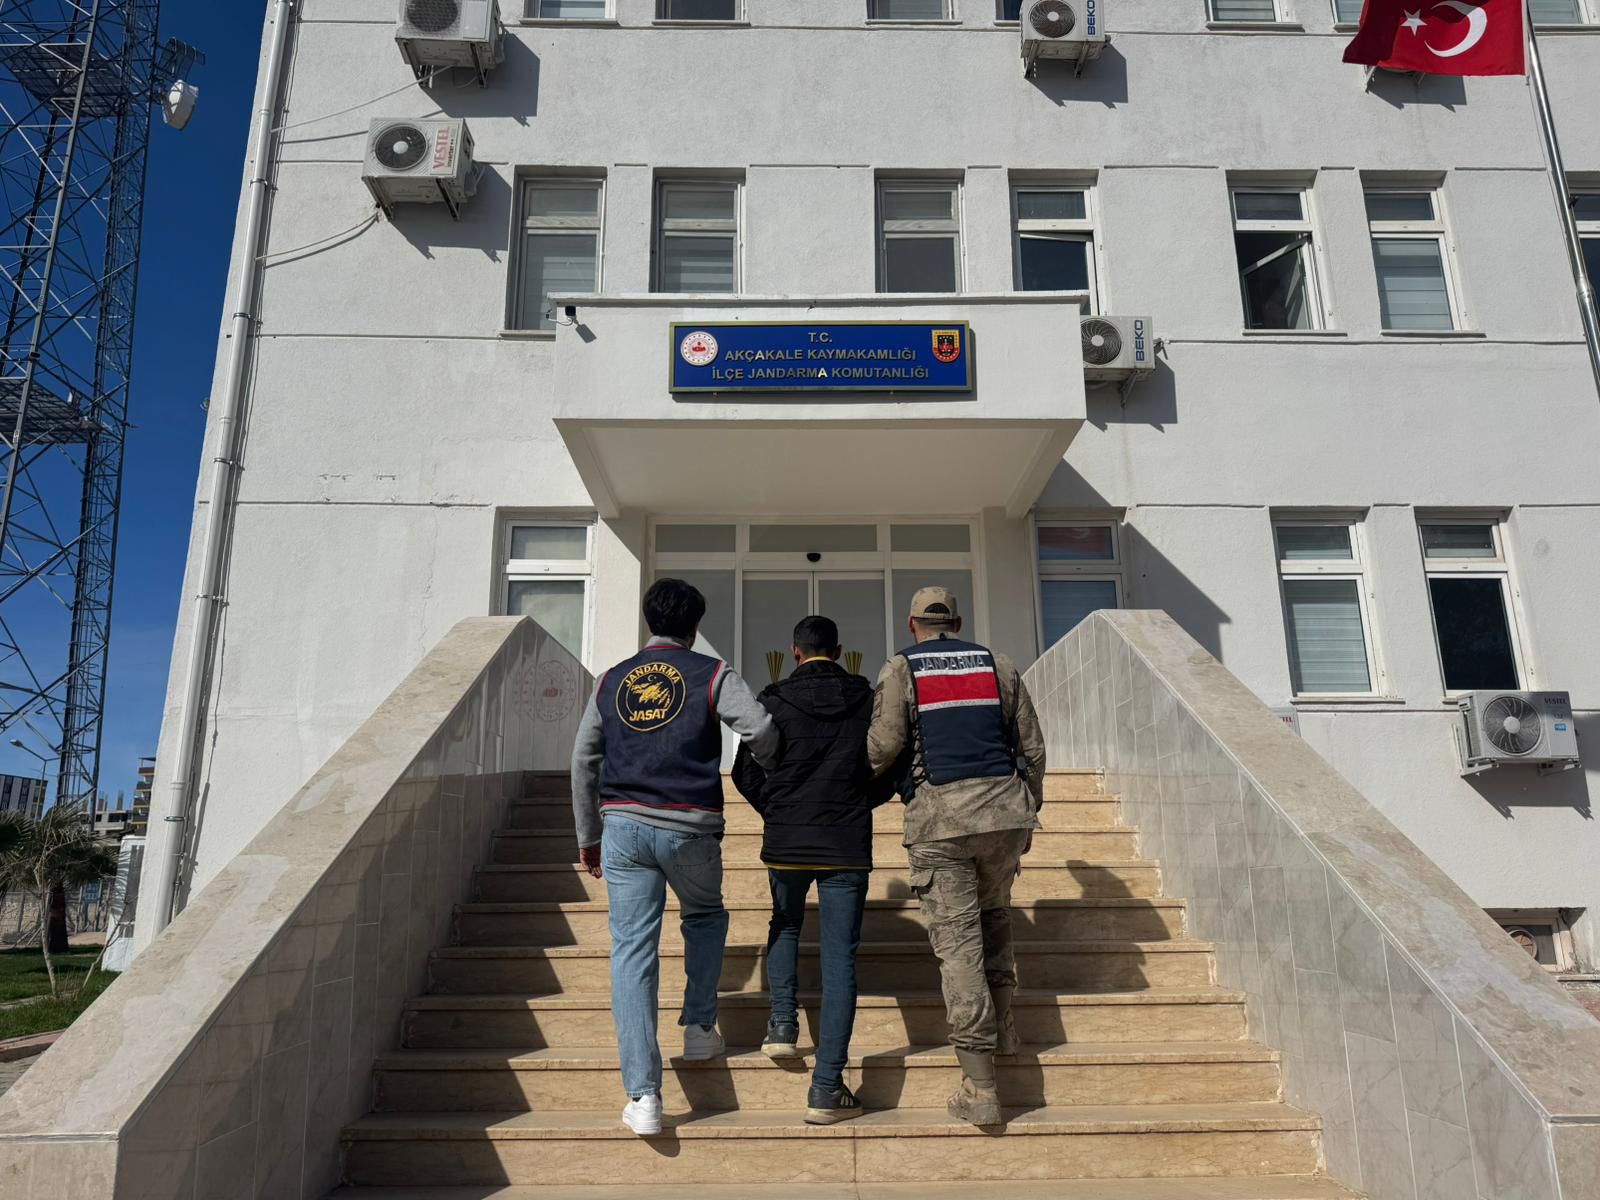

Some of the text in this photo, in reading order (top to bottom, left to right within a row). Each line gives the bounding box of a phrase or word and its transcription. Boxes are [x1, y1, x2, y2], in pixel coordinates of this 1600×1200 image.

[1087, 0, 1096, 35] BEKO
[432, 127, 450, 169] VESTEL
[808, 332, 833, 343] T.C.
[1134, 319, 1145, 361] BEKO
[724, 346, 917, 363] AKÇAKALE KAYMAKAMLIĞI
[711, 364, 929, 381] İLÇE JANDARMA KOMUTANLIĞI
[920, 655, 985, 671] JANDARMA
[625, 663, 681, 687] JANDARMA
[629, 708, 668, 721] JASAT
